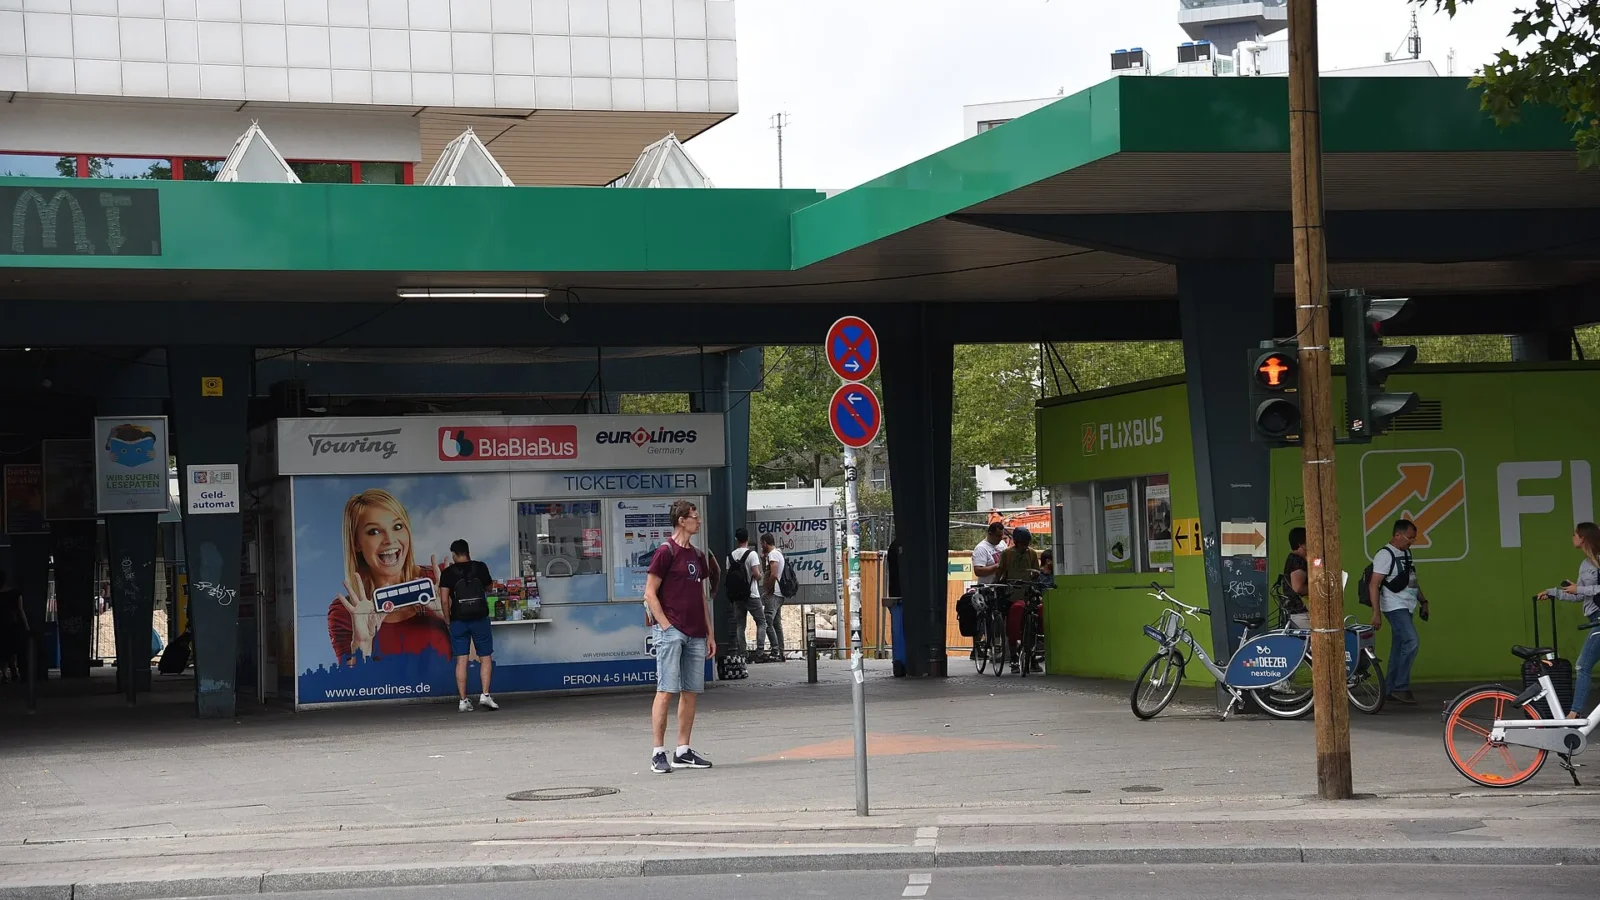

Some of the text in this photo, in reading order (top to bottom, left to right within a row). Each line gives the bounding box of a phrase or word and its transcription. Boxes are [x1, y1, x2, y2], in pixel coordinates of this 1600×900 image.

[308, 429, 401, 459] Touring
[479, 437, 575, 457] BlaBlaBus
[647, 446, 685, 456] Germany
[125, 473, 160, 481] SUCHEN
[564, 473, 697, 490] TICKETCENTER
[106, 480, 160, 489] LESEPATEN
[200, 491, 226, 499] Geld-
[192, 500, 235, 509] automat
[1024, 521, 1050, 530] HITACHI
[1259, 656, 1288, 668] DEEZER
[1250, 669, 1282, 678] nextbike
[563, 674, 601, 685] PERON
[603, 673, 620, 683] 4-5
[325, 682, 431, 698] www.eurolines.de
